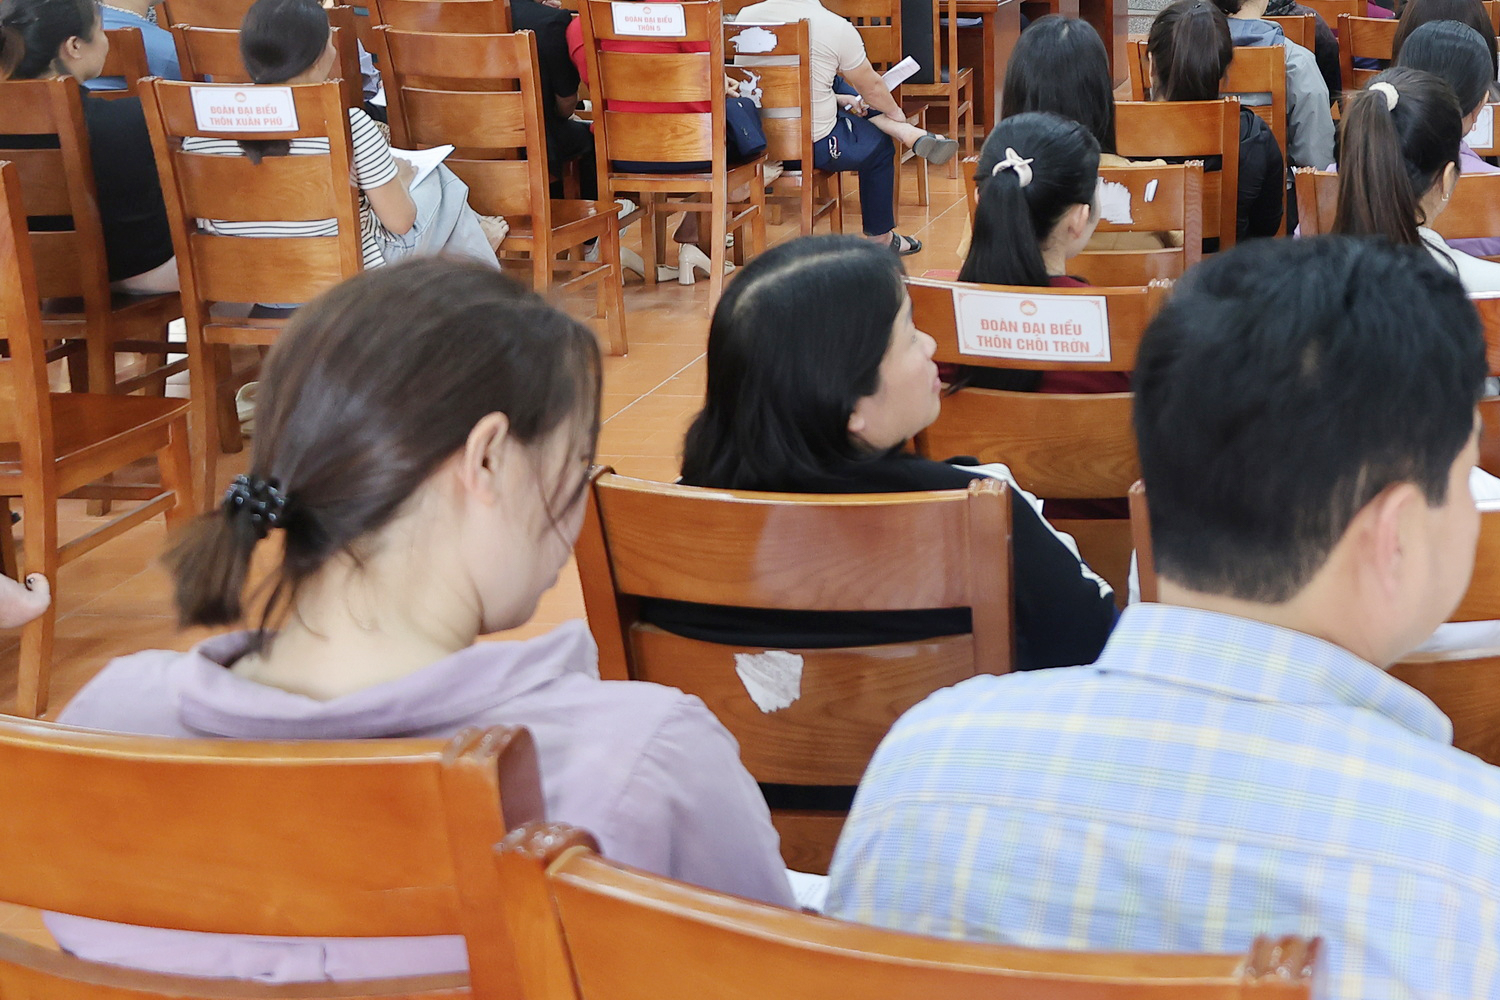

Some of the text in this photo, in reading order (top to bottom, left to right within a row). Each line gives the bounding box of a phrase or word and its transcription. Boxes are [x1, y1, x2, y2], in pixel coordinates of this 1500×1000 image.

[980, 318, 1019, 333] ĐOÀN
[1022, 322, 1046, 336] ĐẠI
[976, 335, 1012, 350] THÔN
